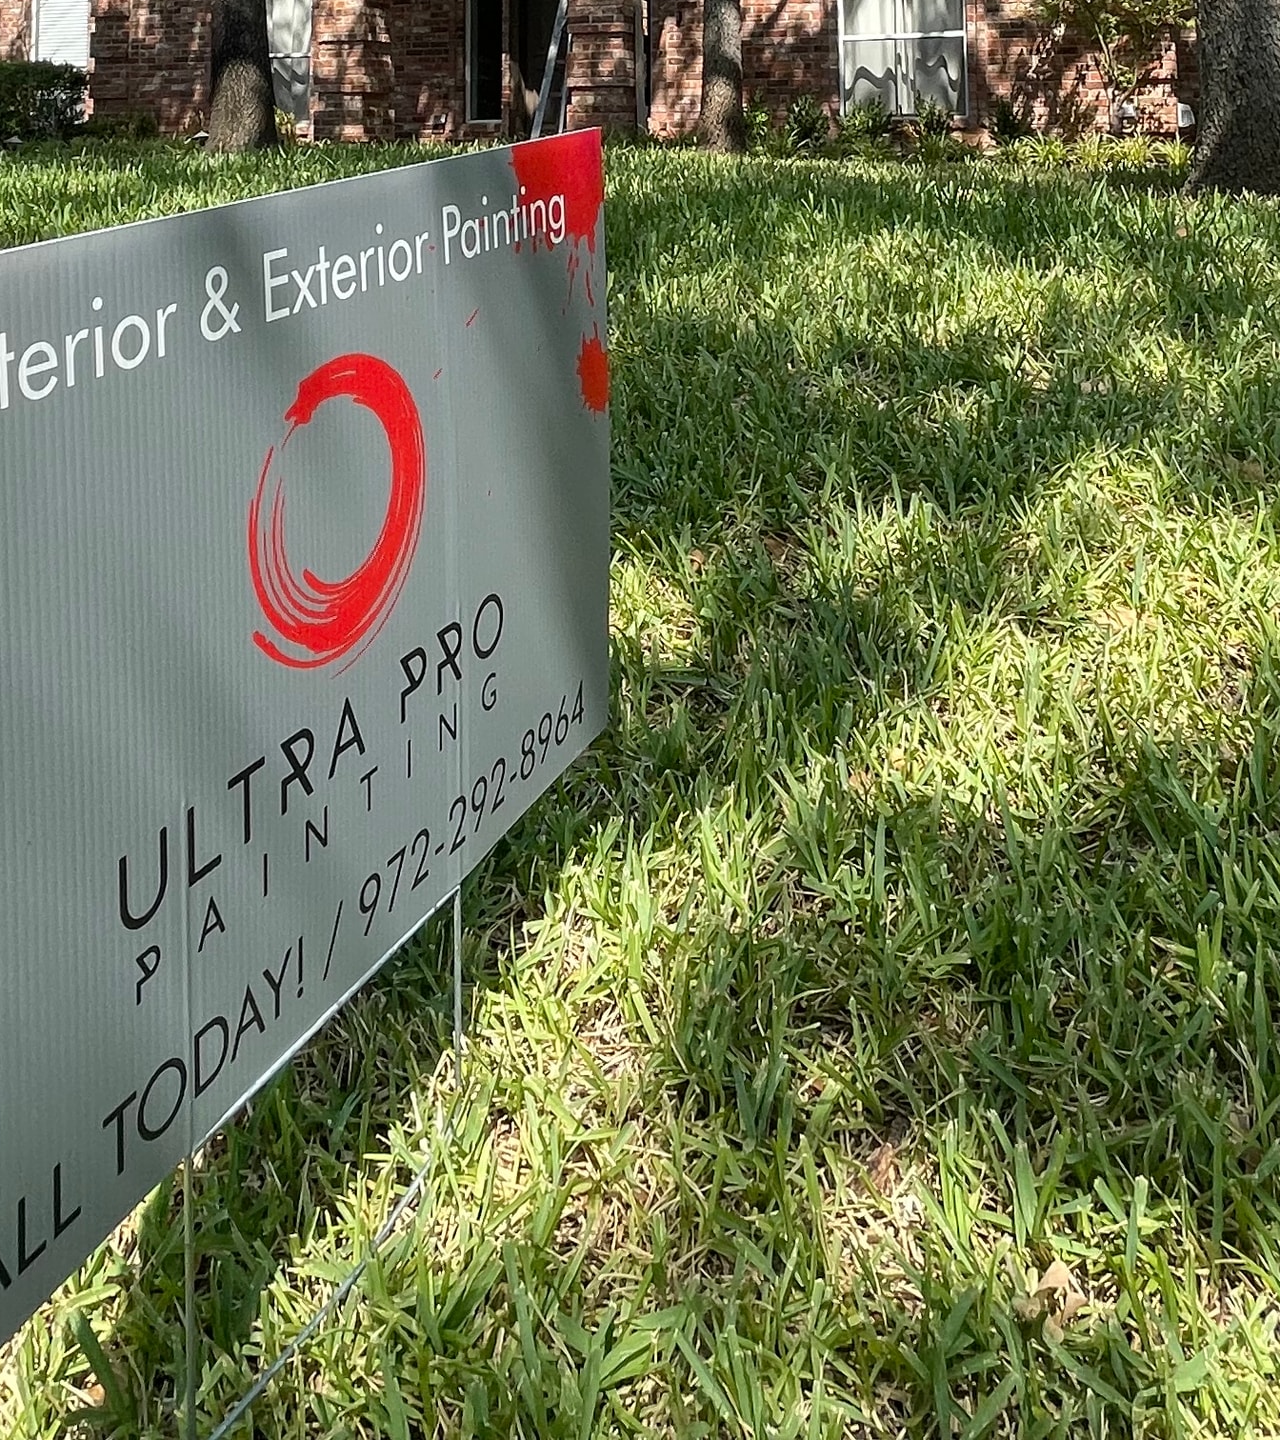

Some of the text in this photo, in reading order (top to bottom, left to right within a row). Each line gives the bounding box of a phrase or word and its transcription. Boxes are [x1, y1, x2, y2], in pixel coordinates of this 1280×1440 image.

[199, 265, 242, 342] &
[263, 222, 428, 323] Exterior
[442, 185, 566, 265] Painting
[102, 936, 304, 1176] TODAY!
[322, 900, 343, 981] /
[358, 680, 585, 937] 972-292-8964
[119, 594, 504, 930] ULTRA PRO
[135, 672, 497, 1006] PAINTING
